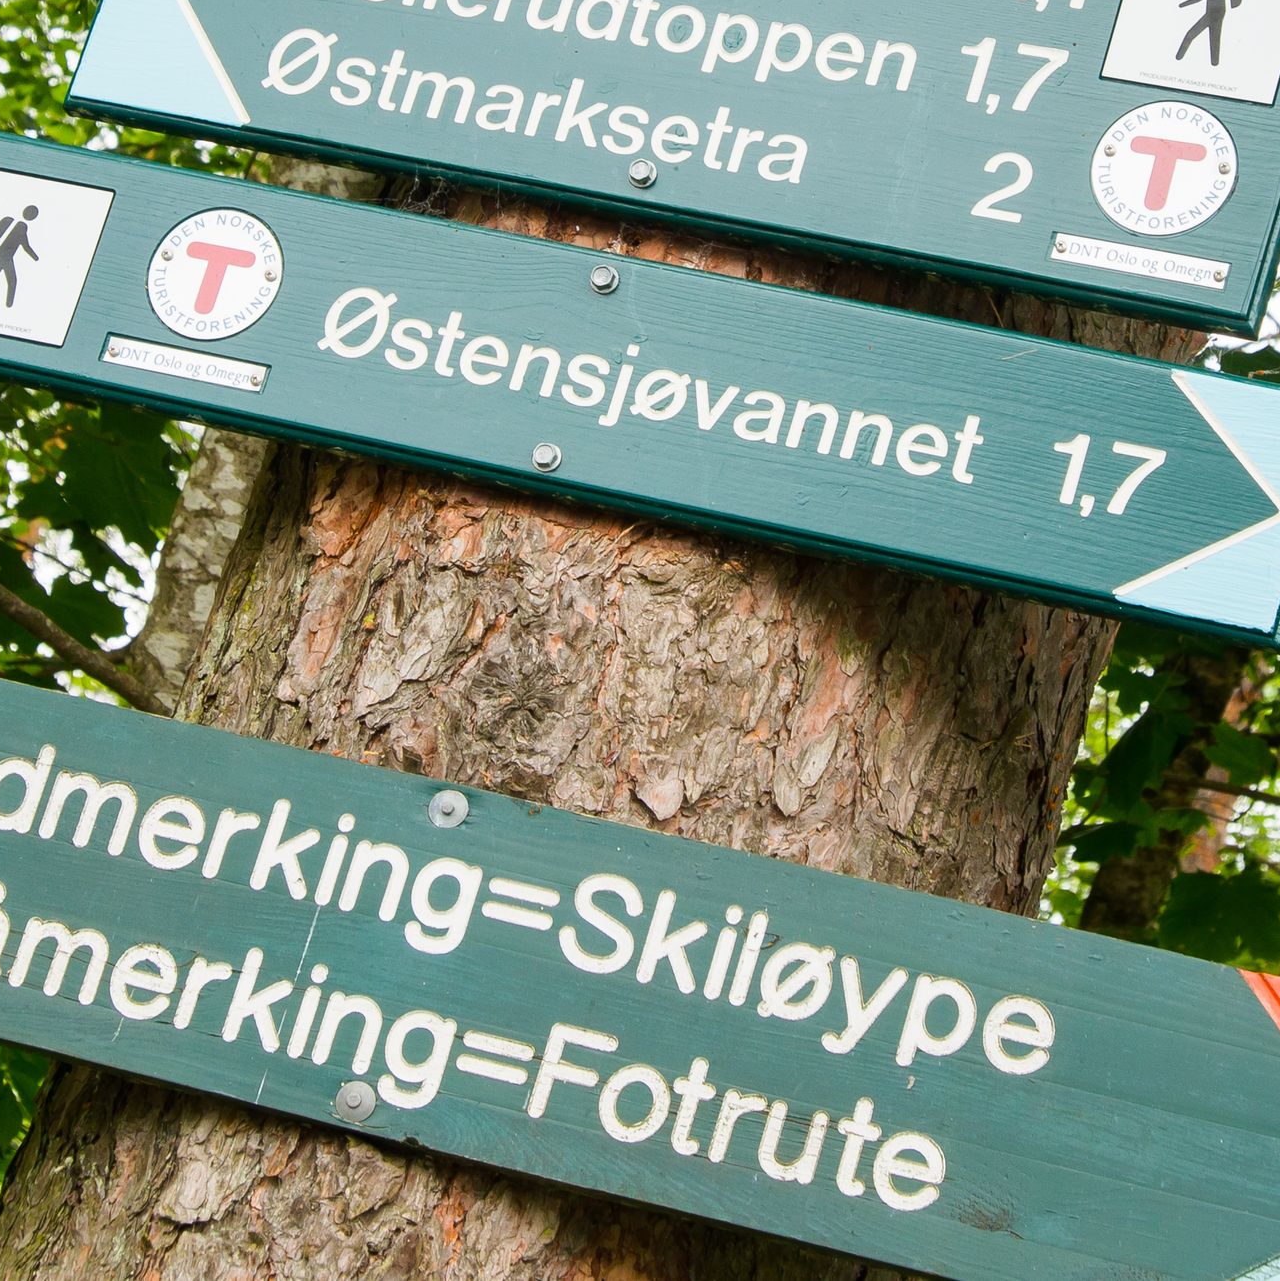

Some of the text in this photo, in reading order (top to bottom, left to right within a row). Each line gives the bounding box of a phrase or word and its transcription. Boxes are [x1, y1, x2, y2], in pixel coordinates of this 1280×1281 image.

[960, 37, 1070, 115] 1,7
[261, 28, 1033, 223] Østmarksetra 2
[1111, 106, 1229, 158] DEN NORSKE
[1098, 163, 1226, 229] TURISTFORENING
[1130, 136, 1207, 211] T
[170, 213, 276, 265] DEN NORSKE
[1068, 241, 1211, 282] DNT Oslo og Omegn
[153, 266, 271, 333] TURISTFORENING
[186, 241, 256, 315] T
[120, 346, 250, 387] DNT Oslo og Omegn
[317, 285, 1167, 517] Østensjøvannet 1,7
